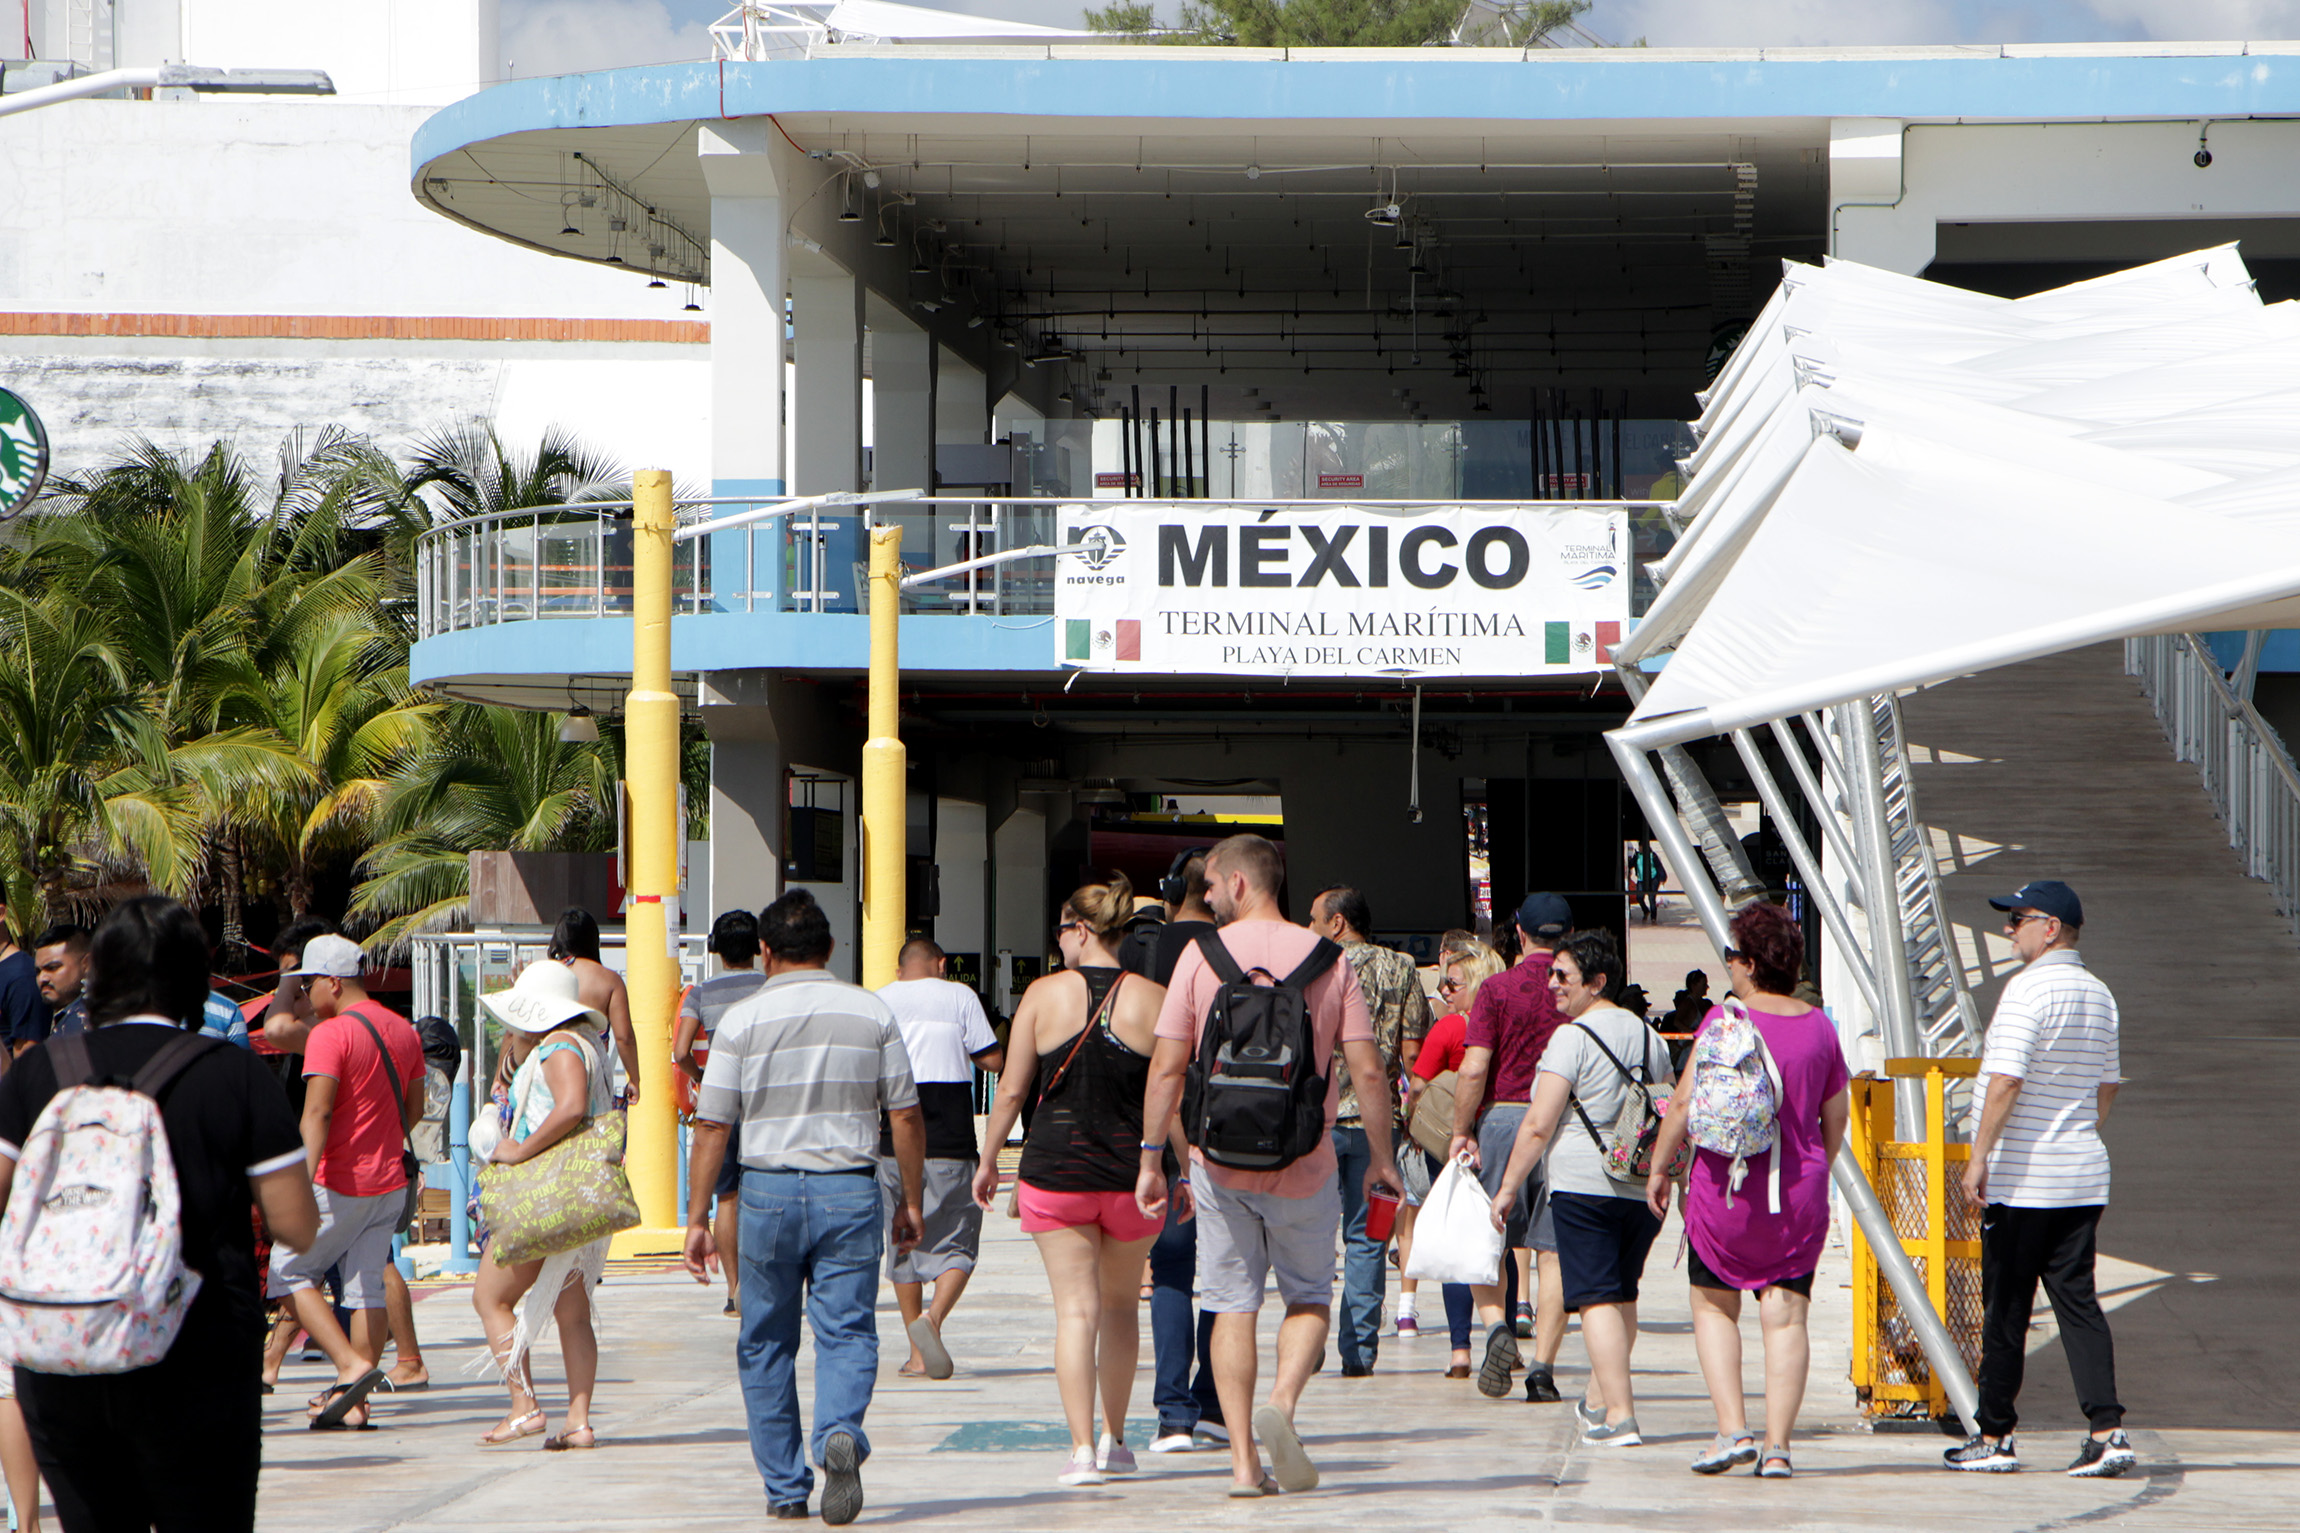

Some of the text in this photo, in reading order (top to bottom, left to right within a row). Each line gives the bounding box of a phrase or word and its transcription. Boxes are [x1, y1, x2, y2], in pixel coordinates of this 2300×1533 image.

[1158, 508, 1530, 590] MÉXICO
[1066, 575, 1126, 586] navega
[1158, 605, 1526, 637] TERMINAL MARÍTIMA
[1222, 646, 1462, 665] PLAYA DEL CARMEN
[584, 1138, 608, 1151] FUN
[564, 1159, 595, 1173] LOVE
[531, 1181, 559, 1201] PINK
[512, 1199, 534, 1219] FUN
[539, 1210, 567, 1232] PINK
[580, 1213, 610, 1235] PINK
